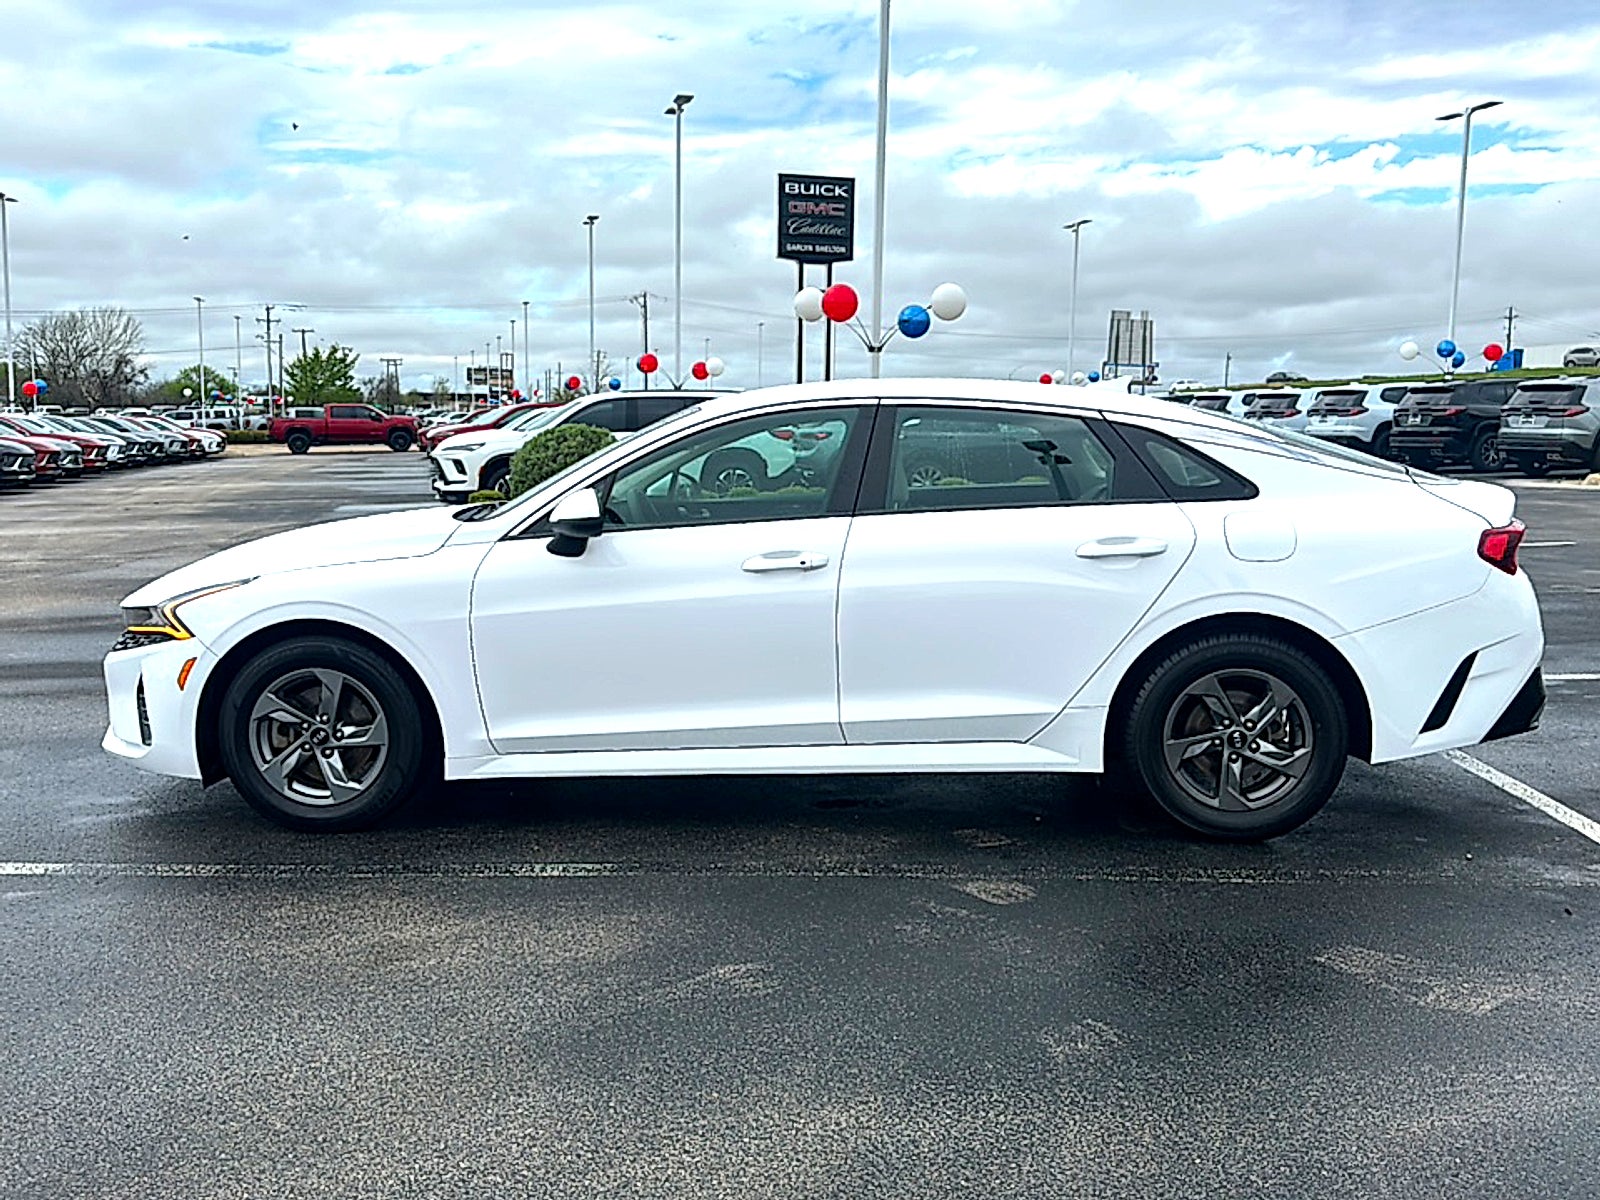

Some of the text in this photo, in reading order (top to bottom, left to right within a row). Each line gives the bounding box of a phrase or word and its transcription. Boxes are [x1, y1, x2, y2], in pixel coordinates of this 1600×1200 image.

[784, 182, 848, 197] BUICK
[788, 201, 846, 216] GMC
[786, 217, 846, 236] Cadillac
